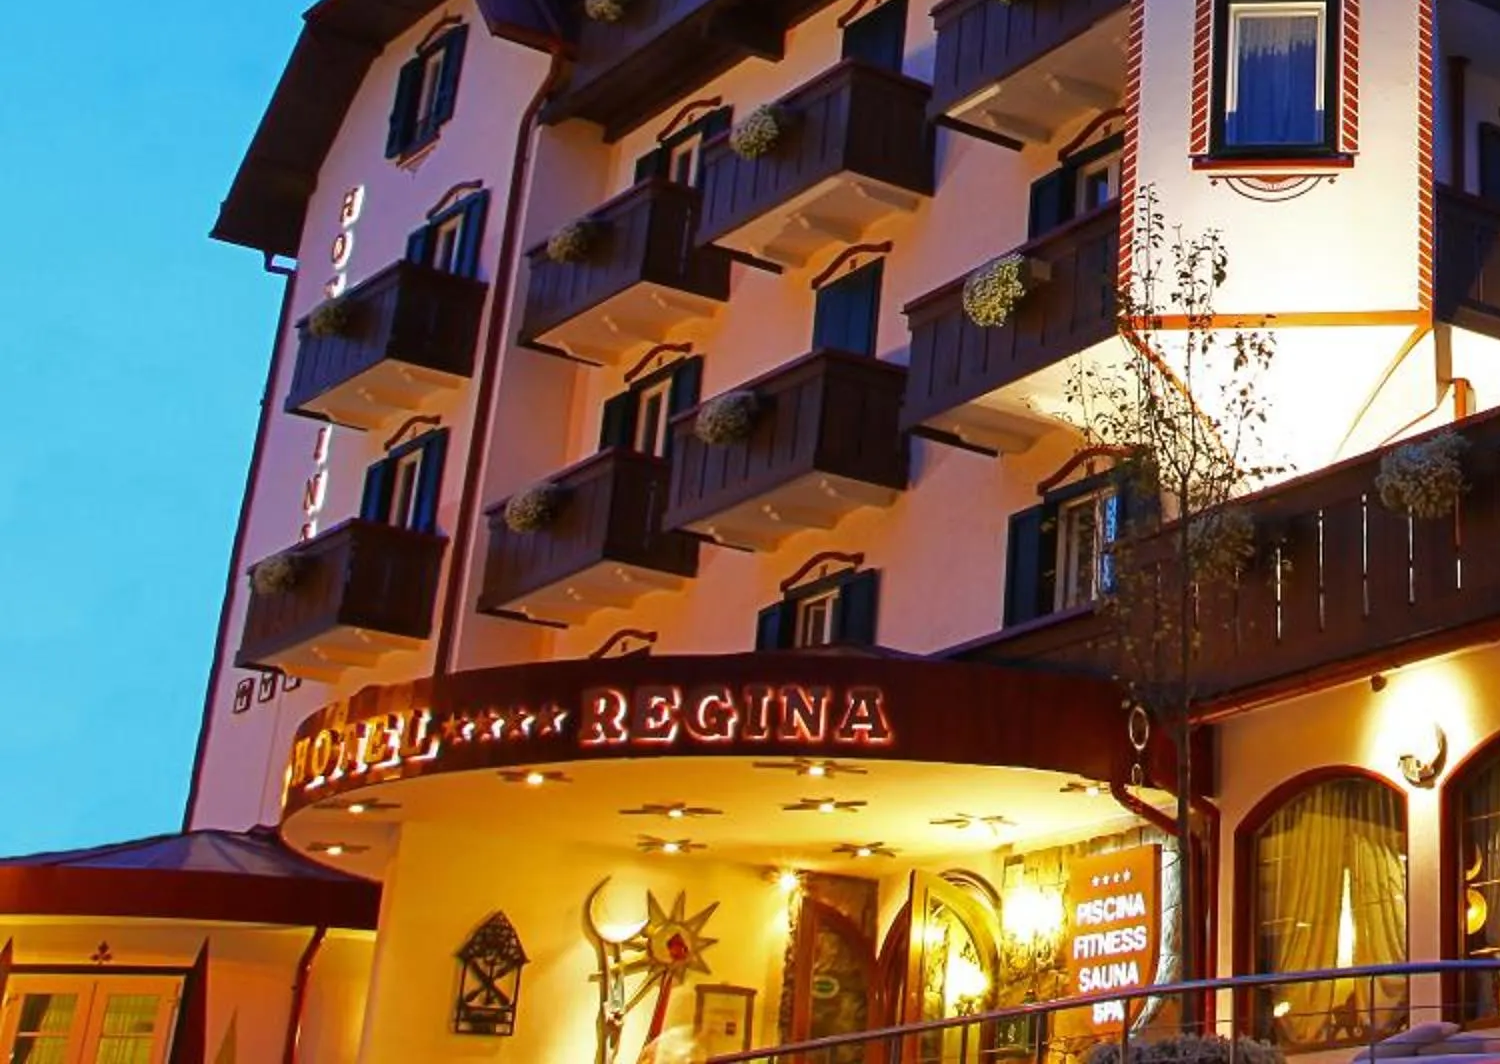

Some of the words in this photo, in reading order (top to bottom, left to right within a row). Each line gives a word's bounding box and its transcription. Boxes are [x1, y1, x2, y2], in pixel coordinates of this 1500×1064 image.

[286, 708, 440, 789] HOTEL
[580, 686, 892, 745] REGINA
[1076, 892, 1146, 926] PISCINA
[1073, 926, 1148, 959] FITNESS
[1078, 961, 1139, 993] SAUNA
[1092, 1000, 1125, 1025] SPA
